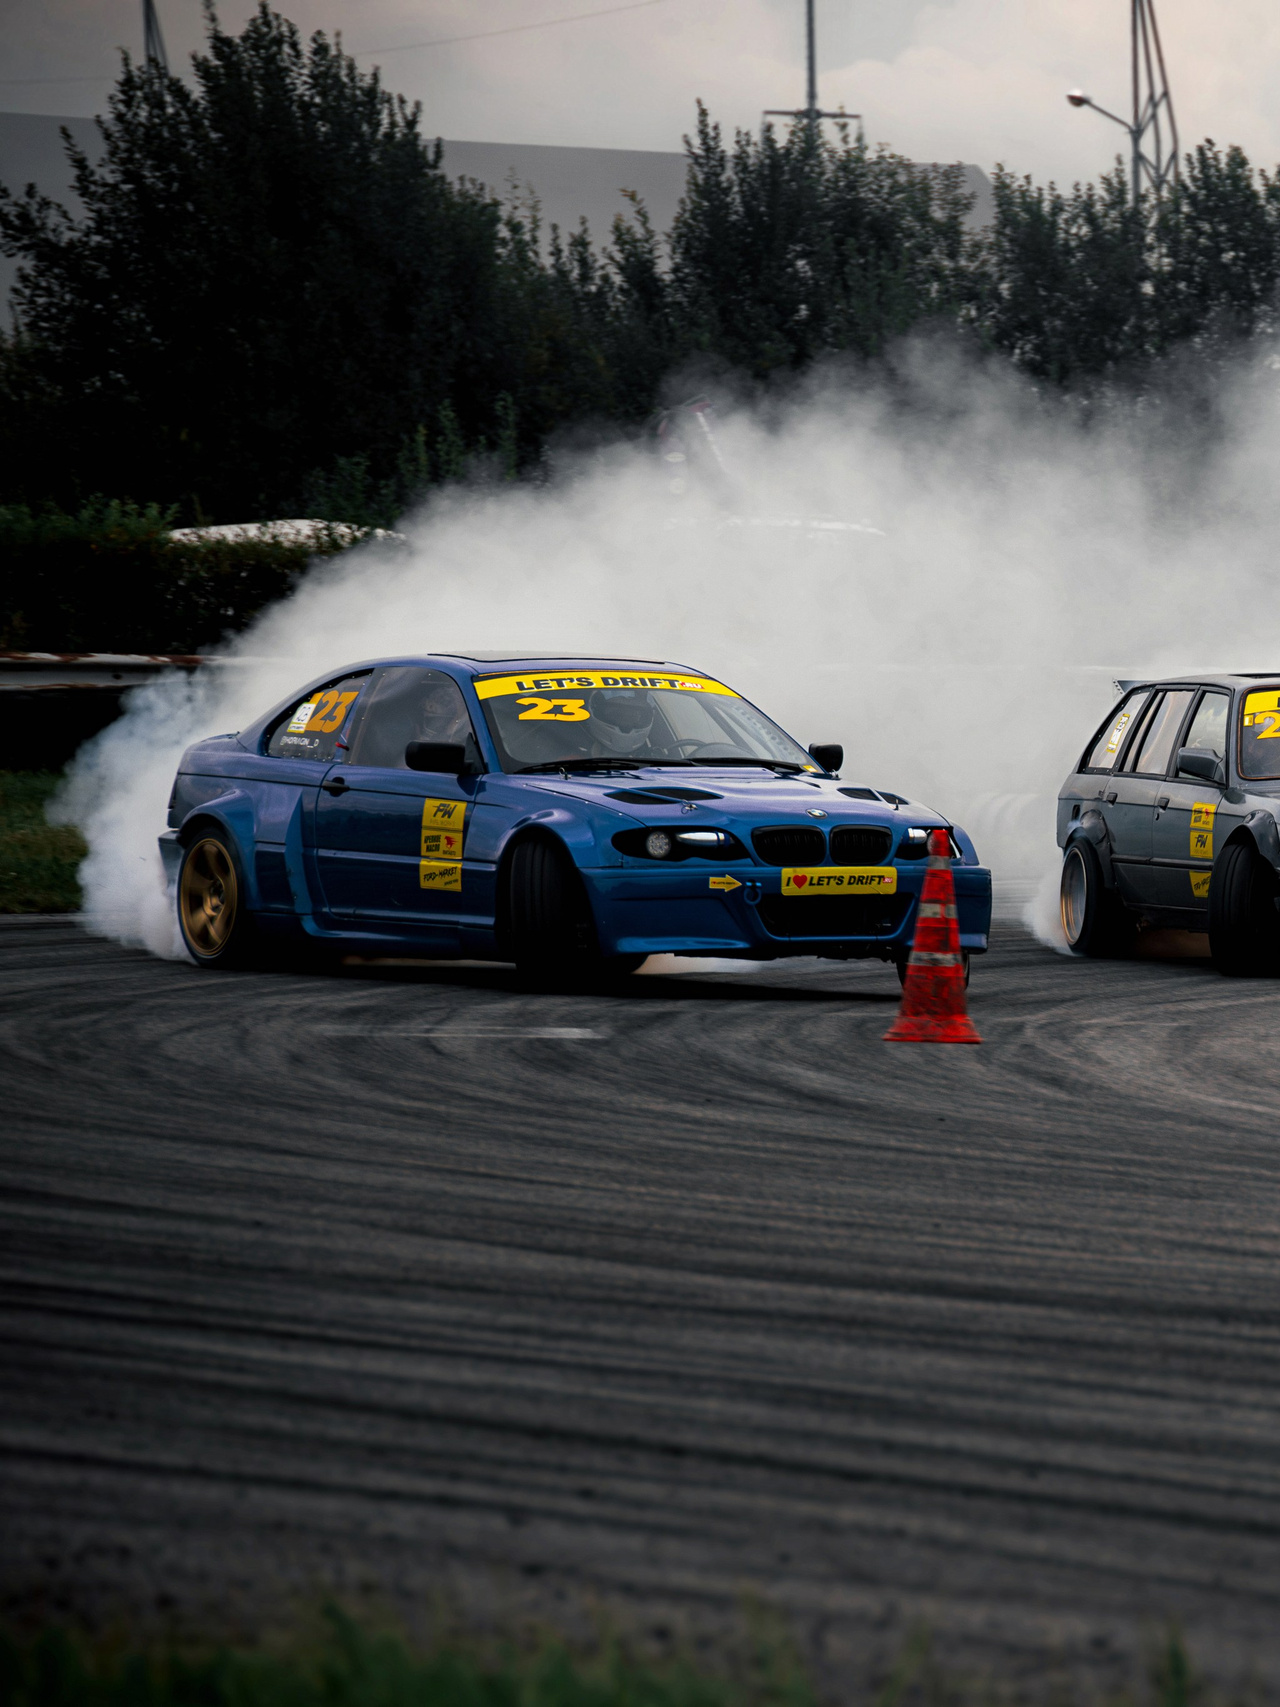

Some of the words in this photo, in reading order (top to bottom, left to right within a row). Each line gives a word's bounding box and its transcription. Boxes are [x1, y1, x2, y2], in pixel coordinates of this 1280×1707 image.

[516, 677, 594, 691] LET'S
[515, 697, 591, 722] 23
[432, 803, 458, 819] FW
[786, 876, 792, 887] I
[808, 875, 845, 886] LET'S
